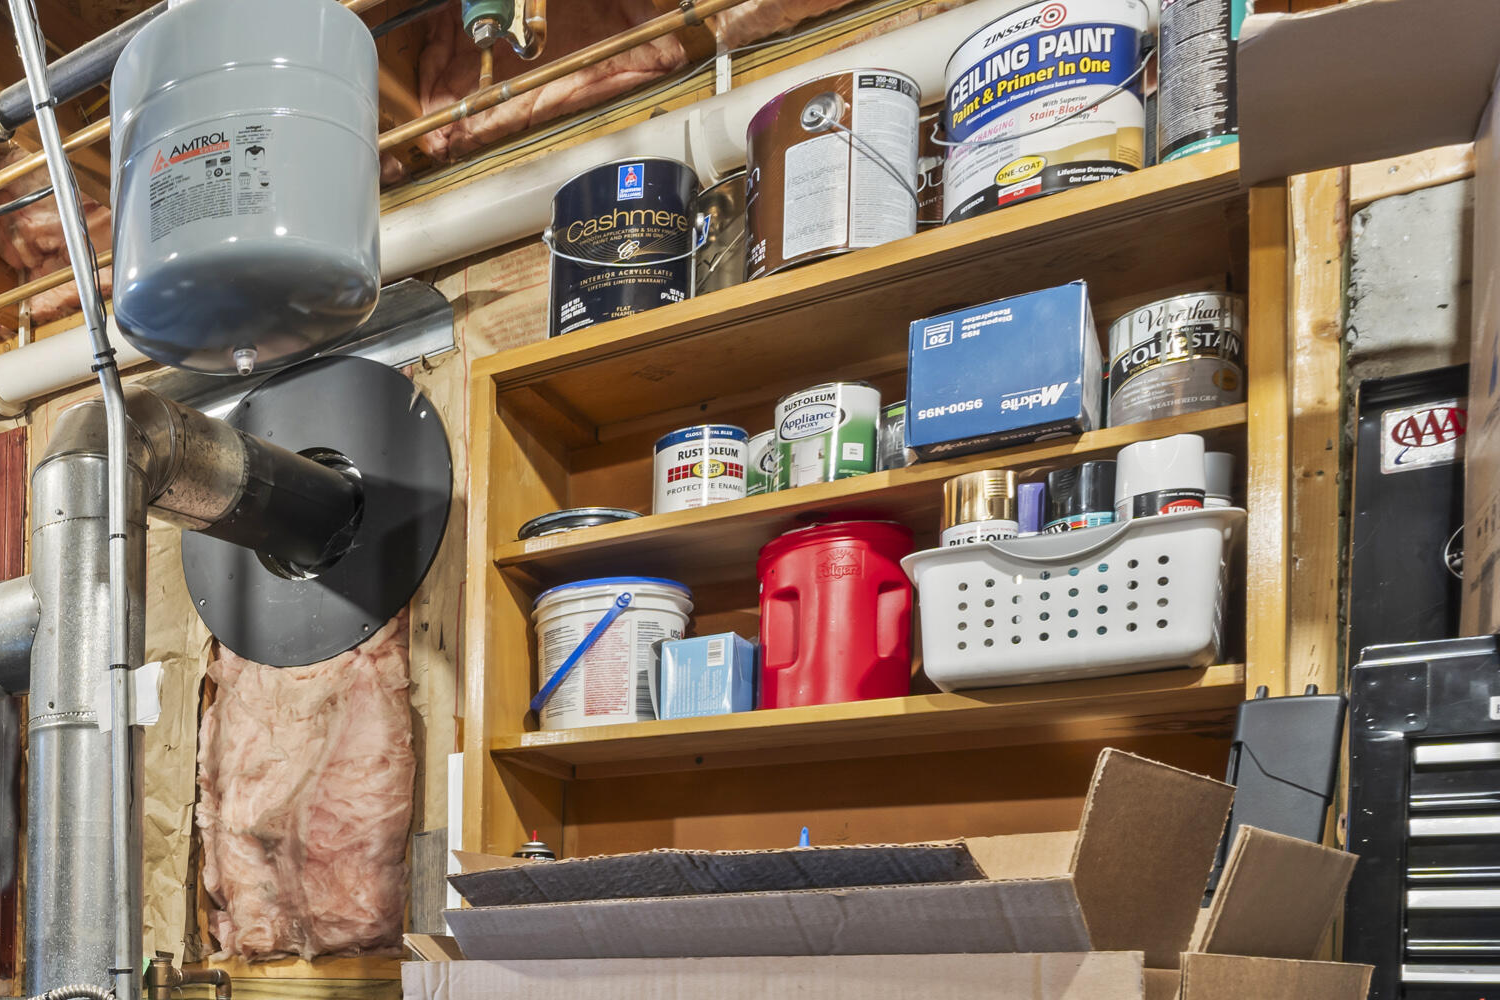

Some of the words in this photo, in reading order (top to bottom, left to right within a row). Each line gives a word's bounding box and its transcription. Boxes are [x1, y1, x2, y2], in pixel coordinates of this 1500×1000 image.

[983, 15, 1041, 49] ZINSSER
[950, 43, 1030, 111] CEILING
[1038, 28, 1115, 62] PAINT
[952, 95, 980, 129] Paint
[982, 87, 994, 106] &
[997, 66, 1055, 98] Primer
[1059, 60, 1076, 77] In
[1079, 57, 1111, 73] One
[1042, 100, 1059, 109] With
[1060, 95, 1088, 106] Superior
[169, 132, 228, 158] AMTROL
[998, 161, 1041, 181] ONE-COAT
[1057, 166, 1086, 176] Lifetime
[1087, 166, 1117, 174] Durability
[567, 208, 689, 243] Cashmere
[603, 227, 641, 238] APPLICATION
[580, 271, 616, 287] INTERIOR
[618, 268, 651, 277] ACRYLIC
[587, 281, 612, 292] LIFETIME
[613, 278, 636, 286] LIMITED
[929, 333, 947, 346] 20
[961, 328, 981, 340] N95
[784, 392, 836, 414] RUST-OLEUM
[1001, 382, 1069, 410] Makrite
[1149, 396, 1198, 411] WEATHERED
[918, 398, 983, 420] 9500-N95
[783, 410, 836, 430] Appliance
[797, 420, 819, 431] EPOXY
[1401, 406, 1467, 447] AAA
[678, 446, 739, 461] RUSTOLEUM
